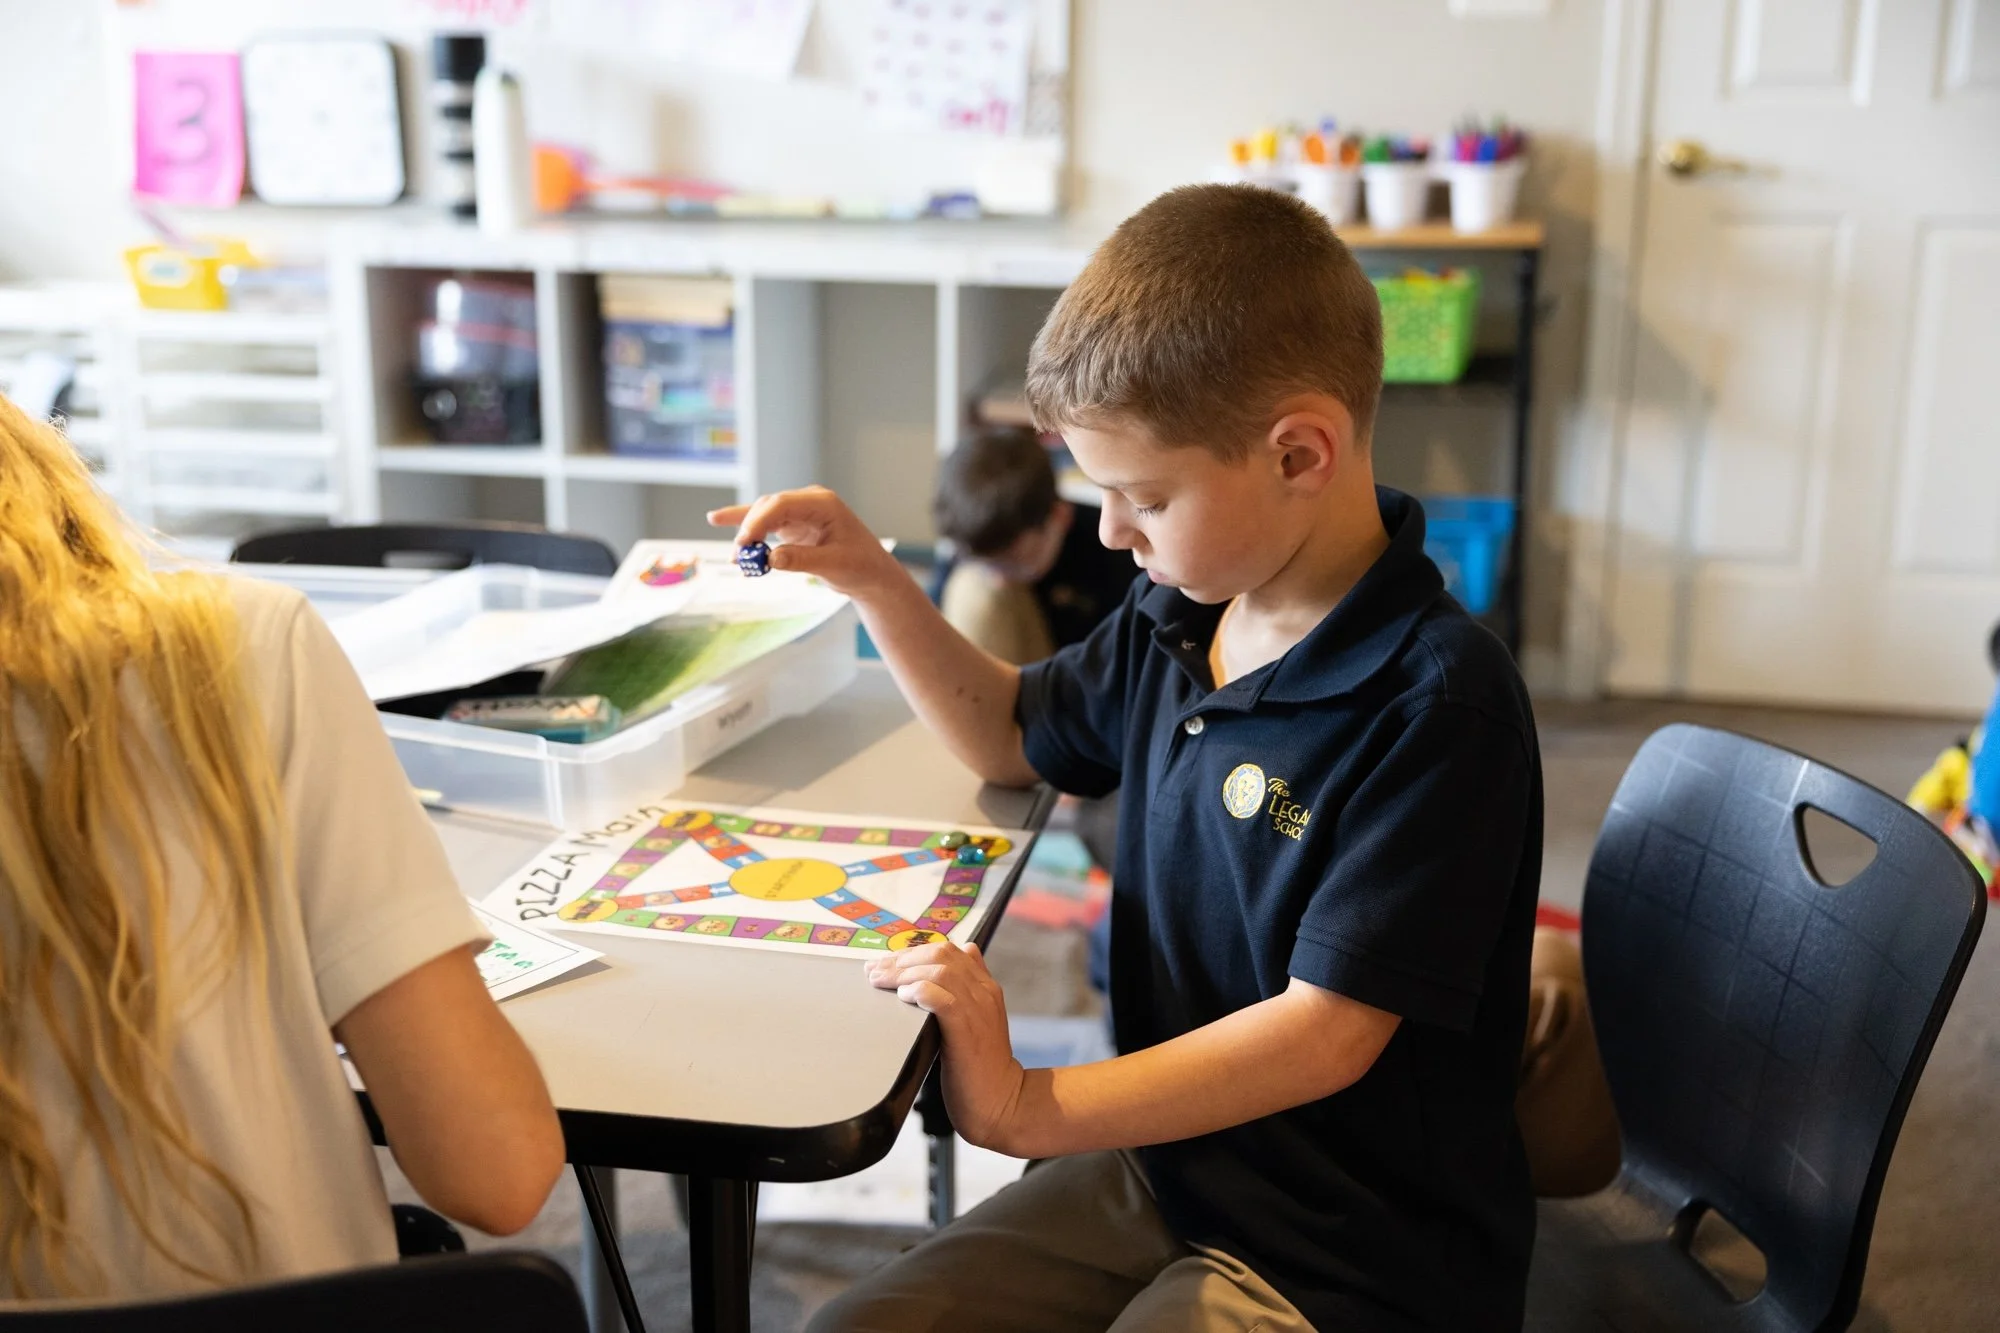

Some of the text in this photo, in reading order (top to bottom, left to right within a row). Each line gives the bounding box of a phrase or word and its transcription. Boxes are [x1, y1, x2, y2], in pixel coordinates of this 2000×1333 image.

[160, 77, 212, 166] 3
[1268, 777, 1290, 797] The
[1268, 795, 1312, 827] LEGA
[516, 851, 591, 921] PIZZA
